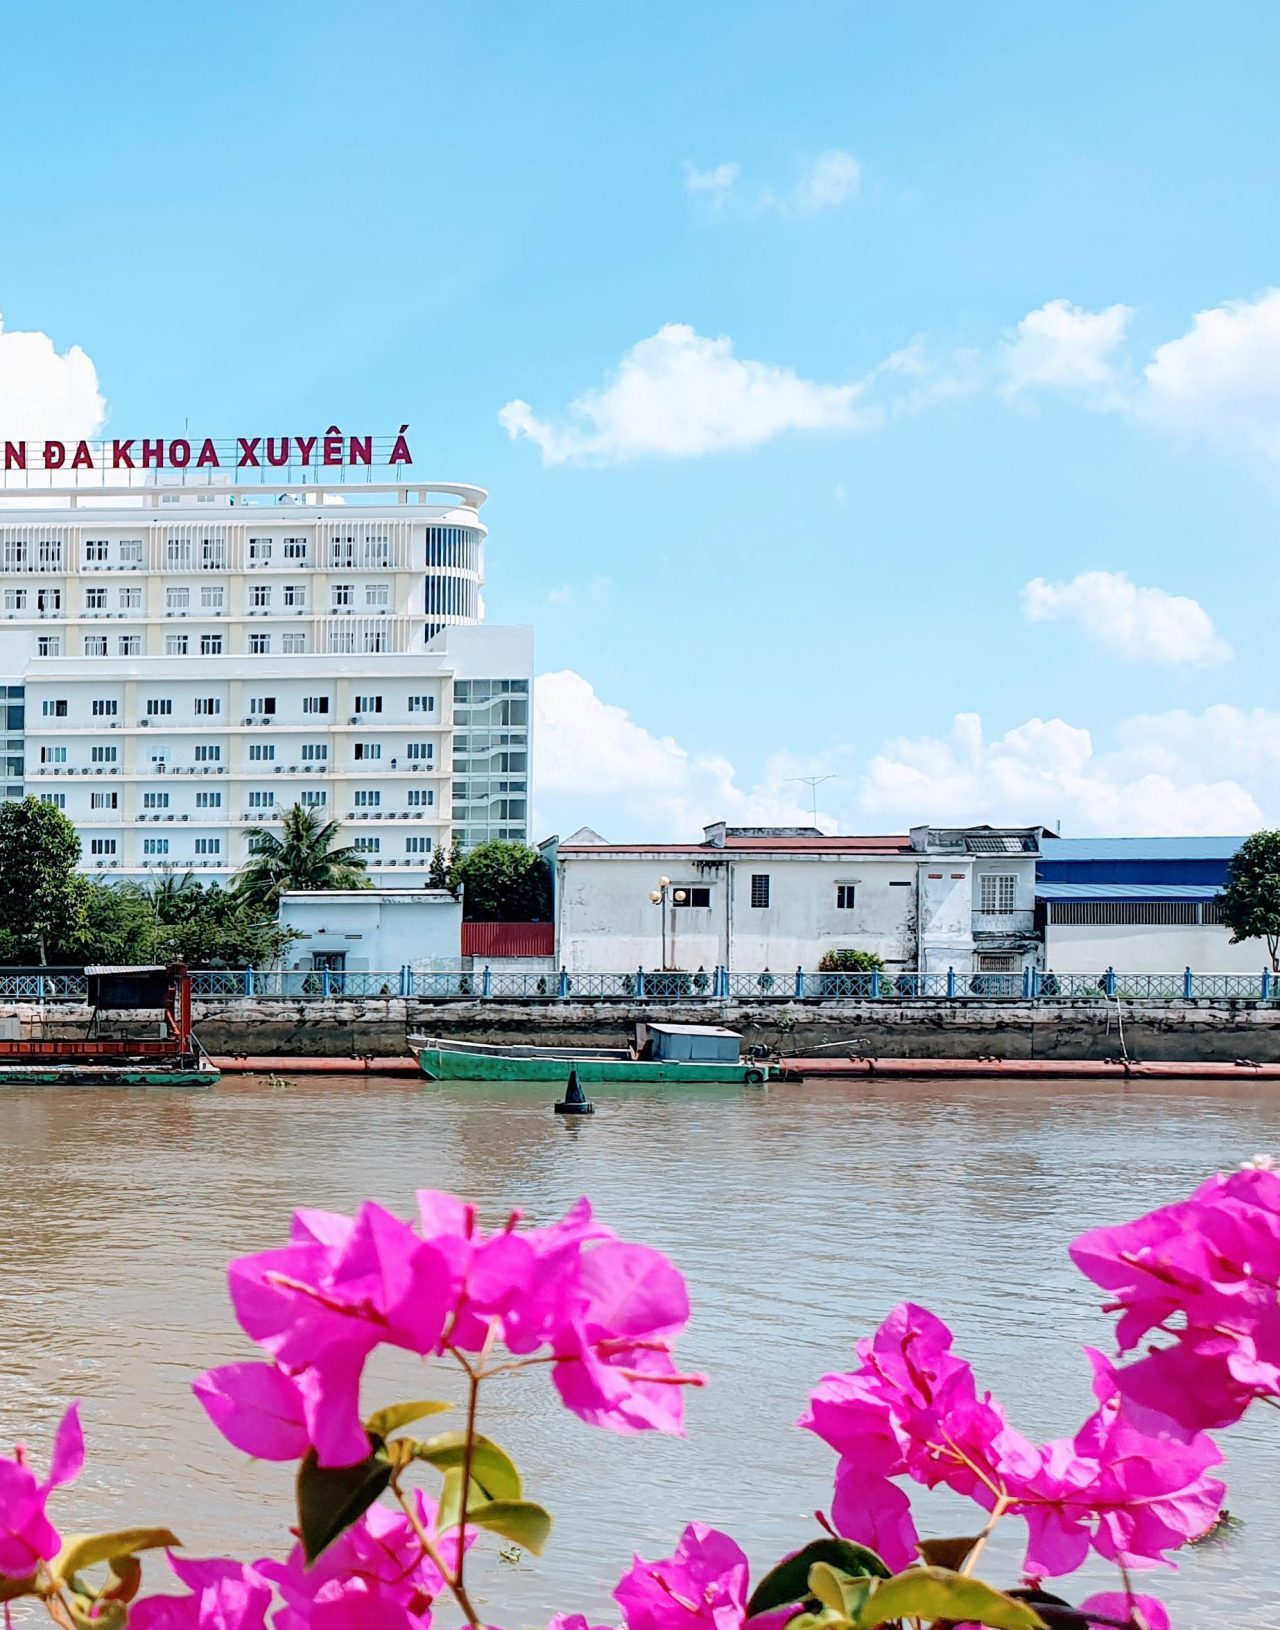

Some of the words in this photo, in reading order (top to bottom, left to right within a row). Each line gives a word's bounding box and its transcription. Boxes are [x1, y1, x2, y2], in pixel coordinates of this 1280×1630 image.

[42, 440, 94, 470] ĐA
[112, 438, 220, 469] KHOA
[236, 426, 372, 467] XUYÊN
[388, 424, 413, 464] Á
